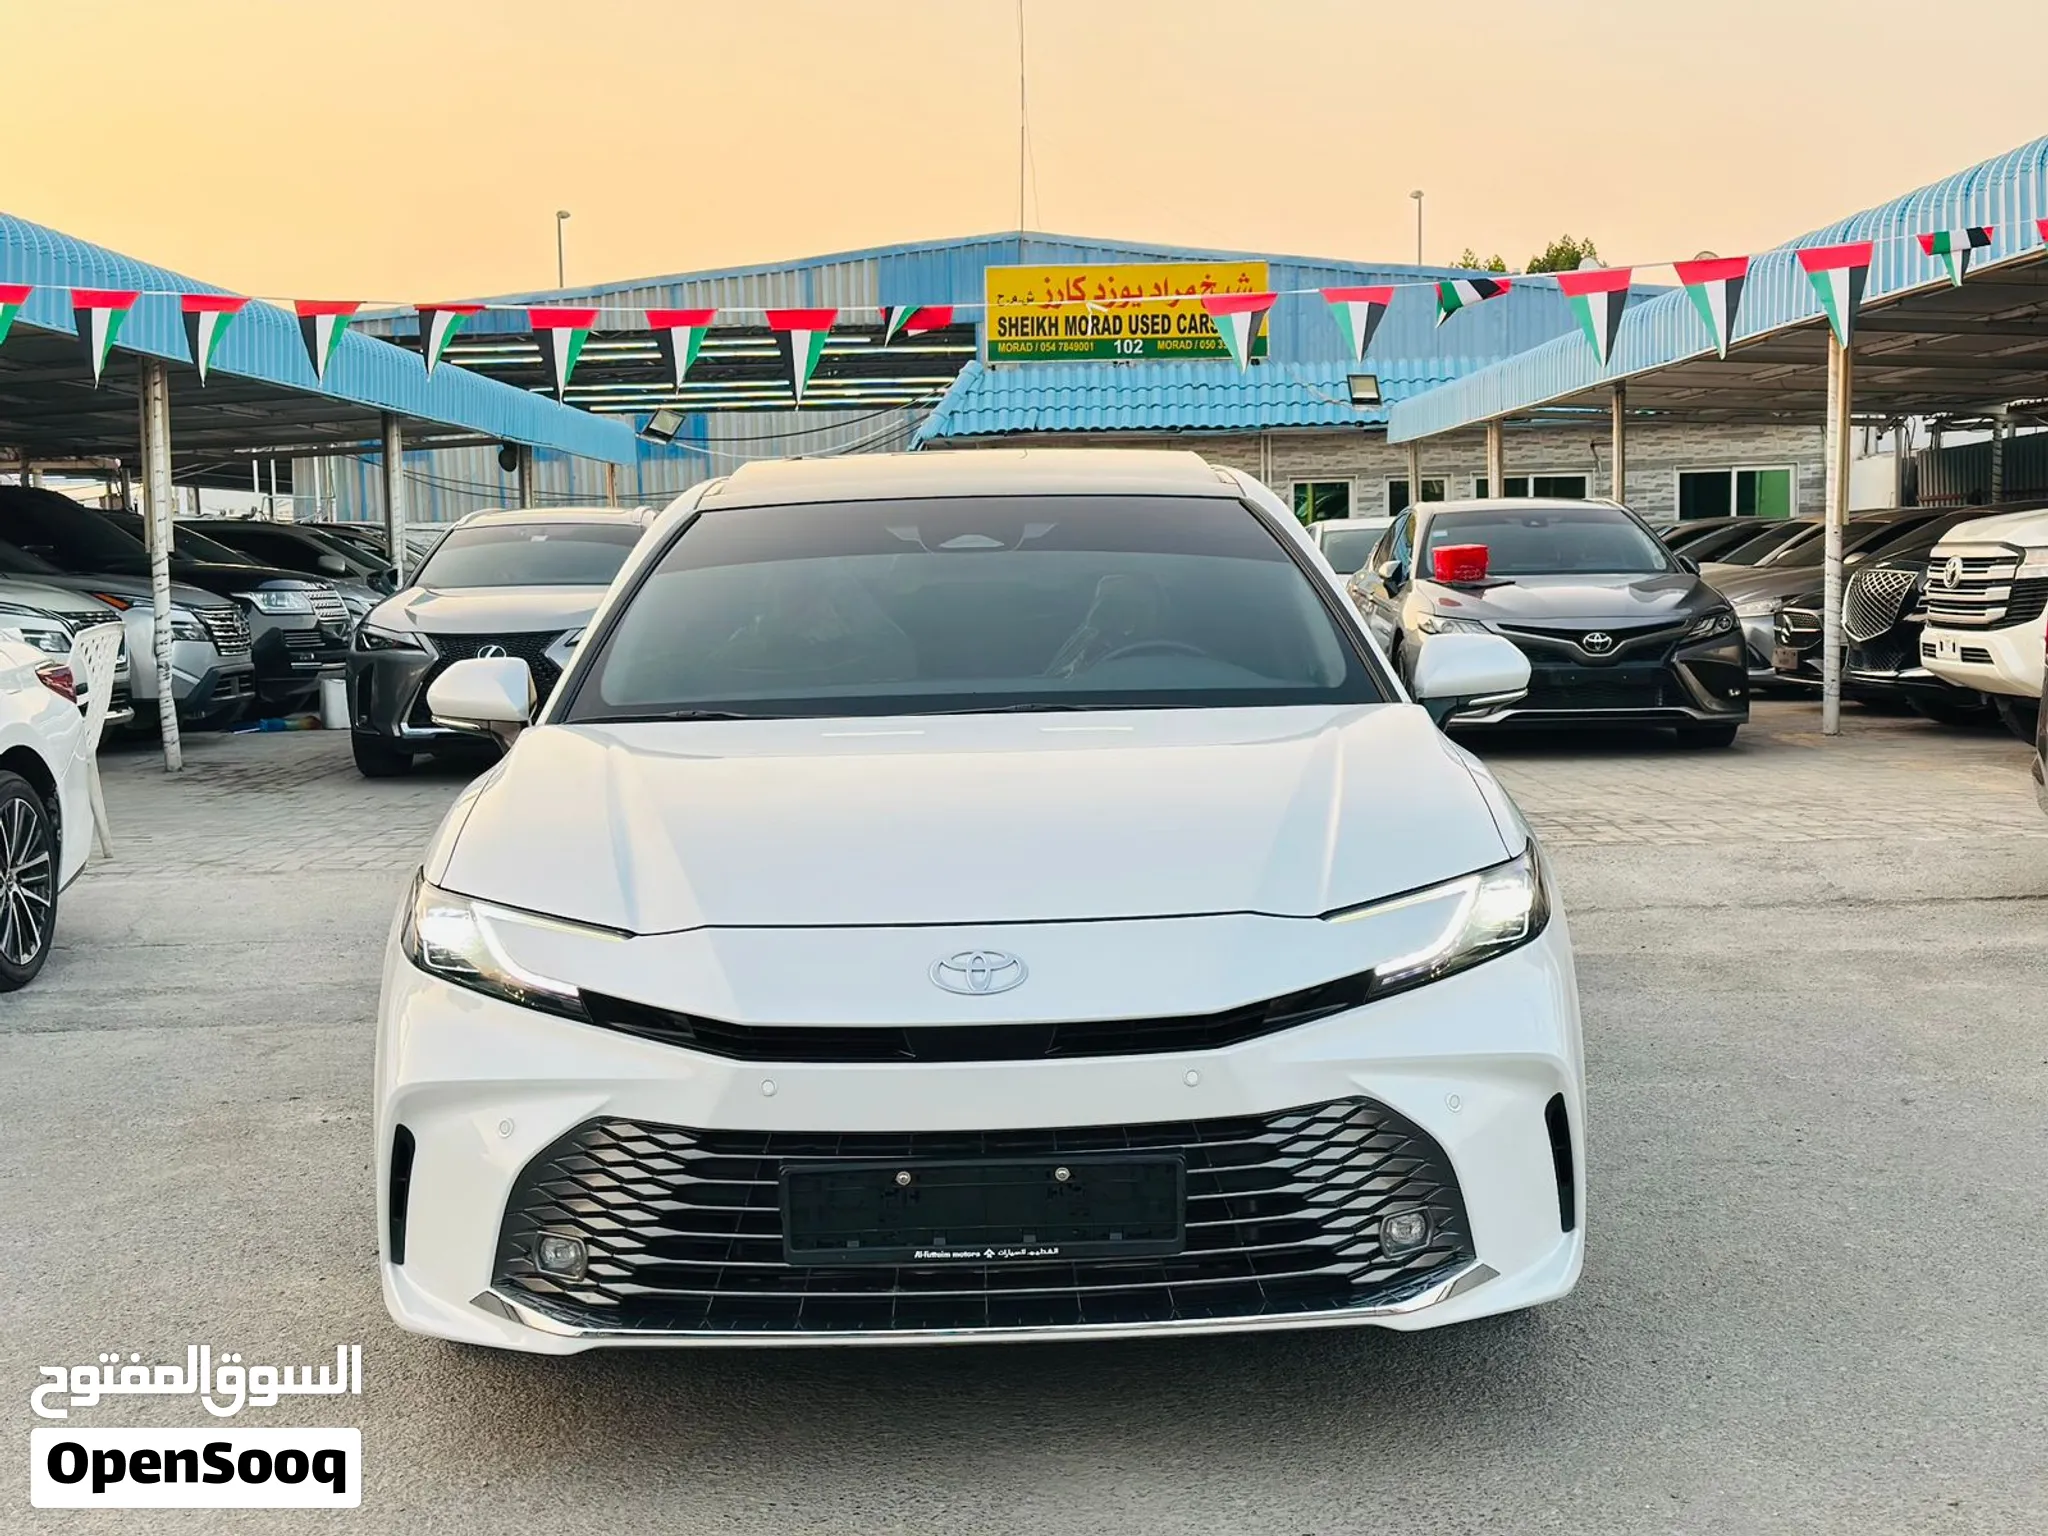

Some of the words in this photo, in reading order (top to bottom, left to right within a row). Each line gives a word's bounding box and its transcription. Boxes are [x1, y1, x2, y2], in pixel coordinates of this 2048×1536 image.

[1038, 275, 1087, 309] كارز
[1094, 276, 1143, 309] يوزد
[1150, 277, 1196, 308] مراد
[1200, 272, 1254, 309] شخ
[998, 316, 1059, 337] SHEIKH
[1065, 314, 1123, 336] MORAD
[1129, 314, 1171, 335] USED
[998, 342, 1033, 353] MORAD
[1040, 342, 1056, 352] 054
[1058, 341, 1095, 352] 7849001
[1113, 339, 1144, 354] 102
[1157, 340, 1193, 351] MORAD
[1199, 340, 1216, 350] 050
